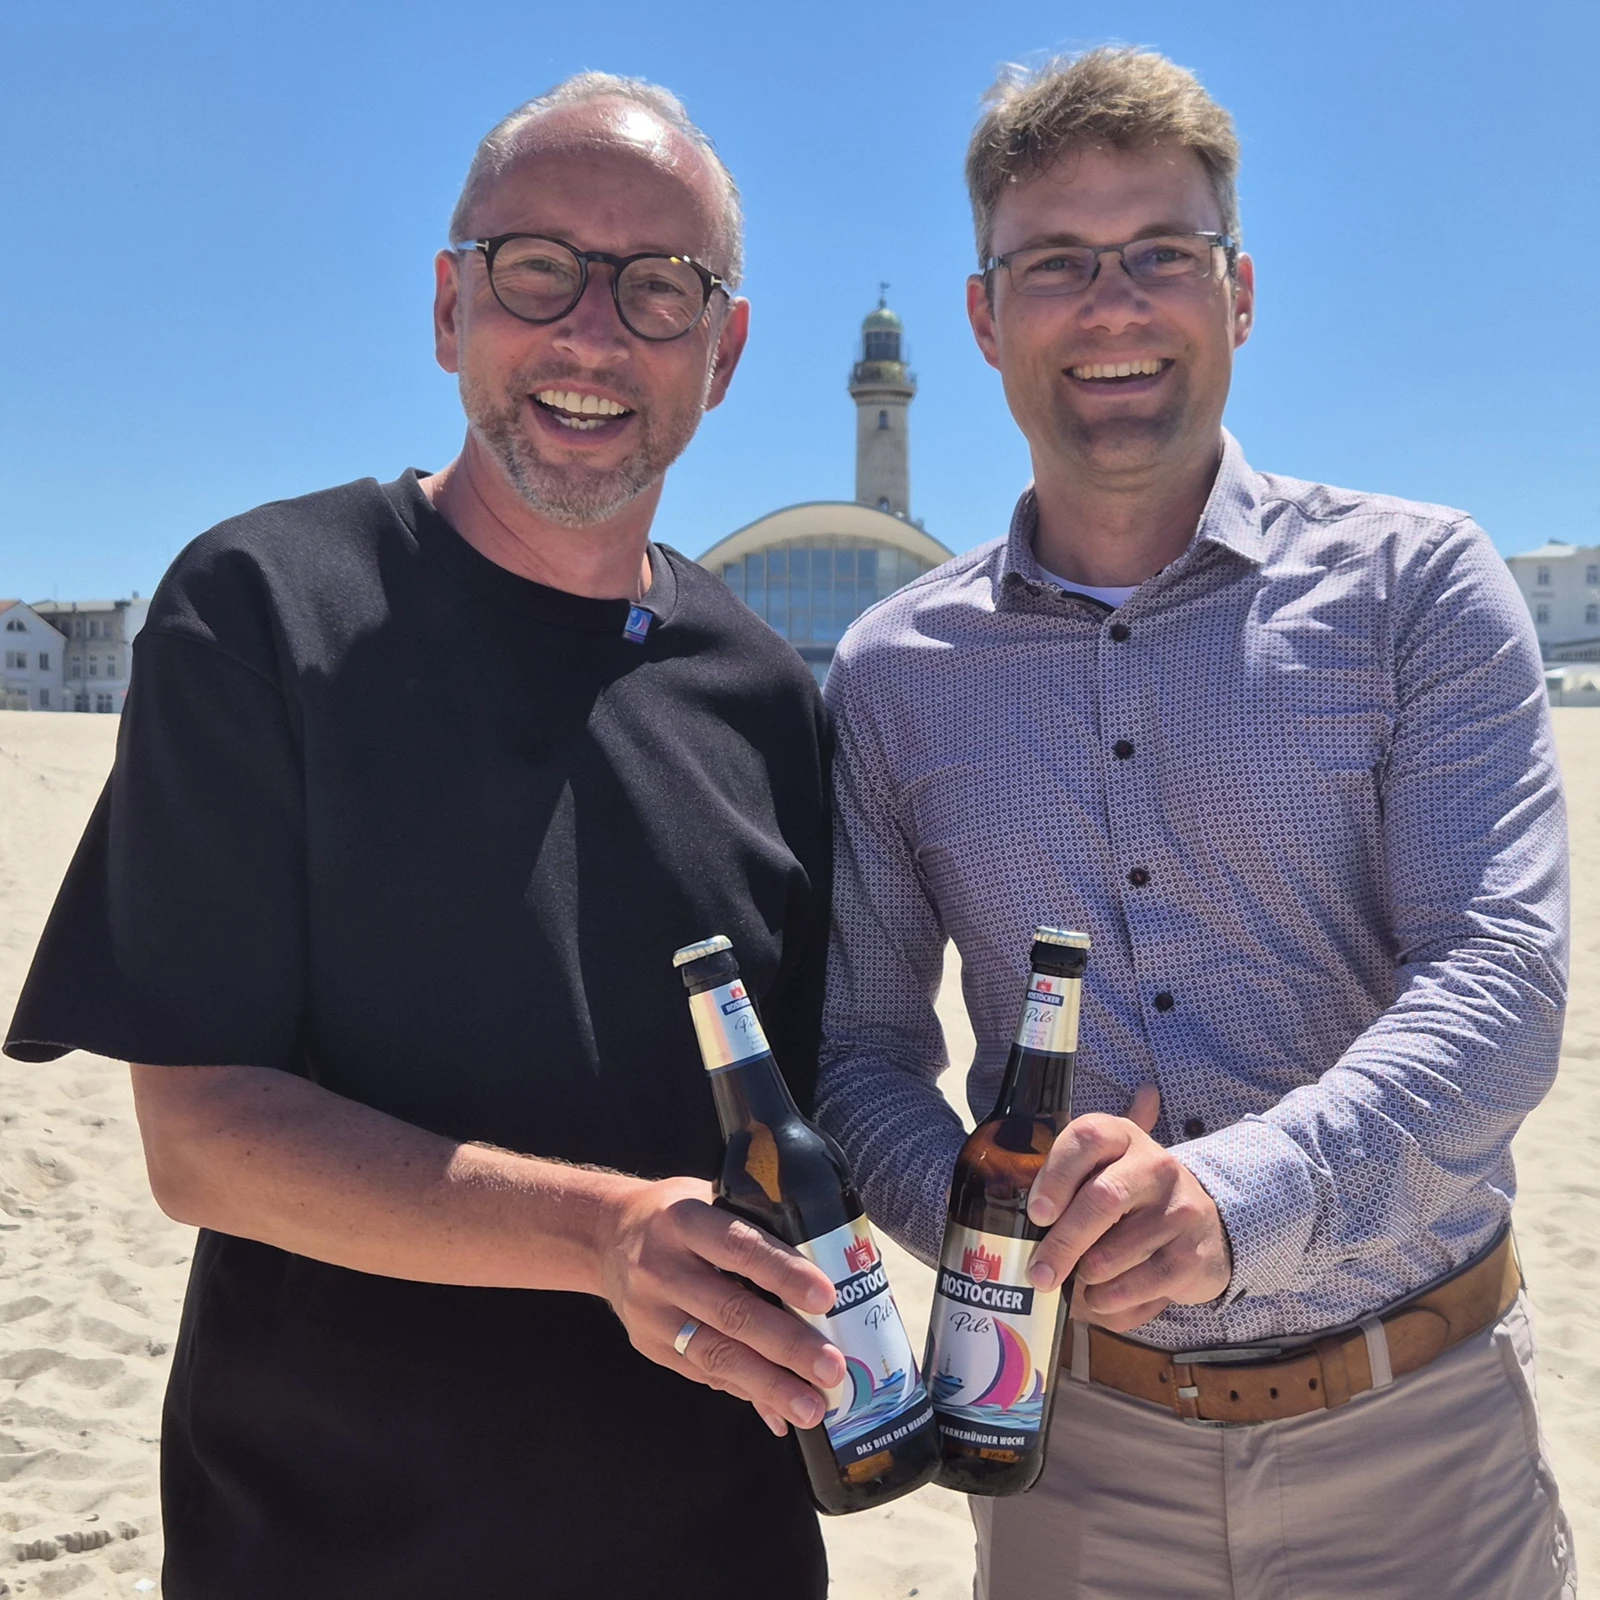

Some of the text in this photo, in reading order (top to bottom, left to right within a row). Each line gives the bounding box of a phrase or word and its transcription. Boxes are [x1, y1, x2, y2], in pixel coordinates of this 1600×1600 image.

[1027, 991, 1061, 1005] OSTOCKER
[1023, 1006, 1055, 1024] Pils
[942, 1273, 1024, 1310] ROSTOCKER
[949, 1311, 993, 1334] Pils
[856, 1442, 873, 1455] DAS
[873, 1433, 894, 1449] BIER
[893, 1426, 909, 1440] DER
[999, 1436, 1026, 1446] WOCHE
